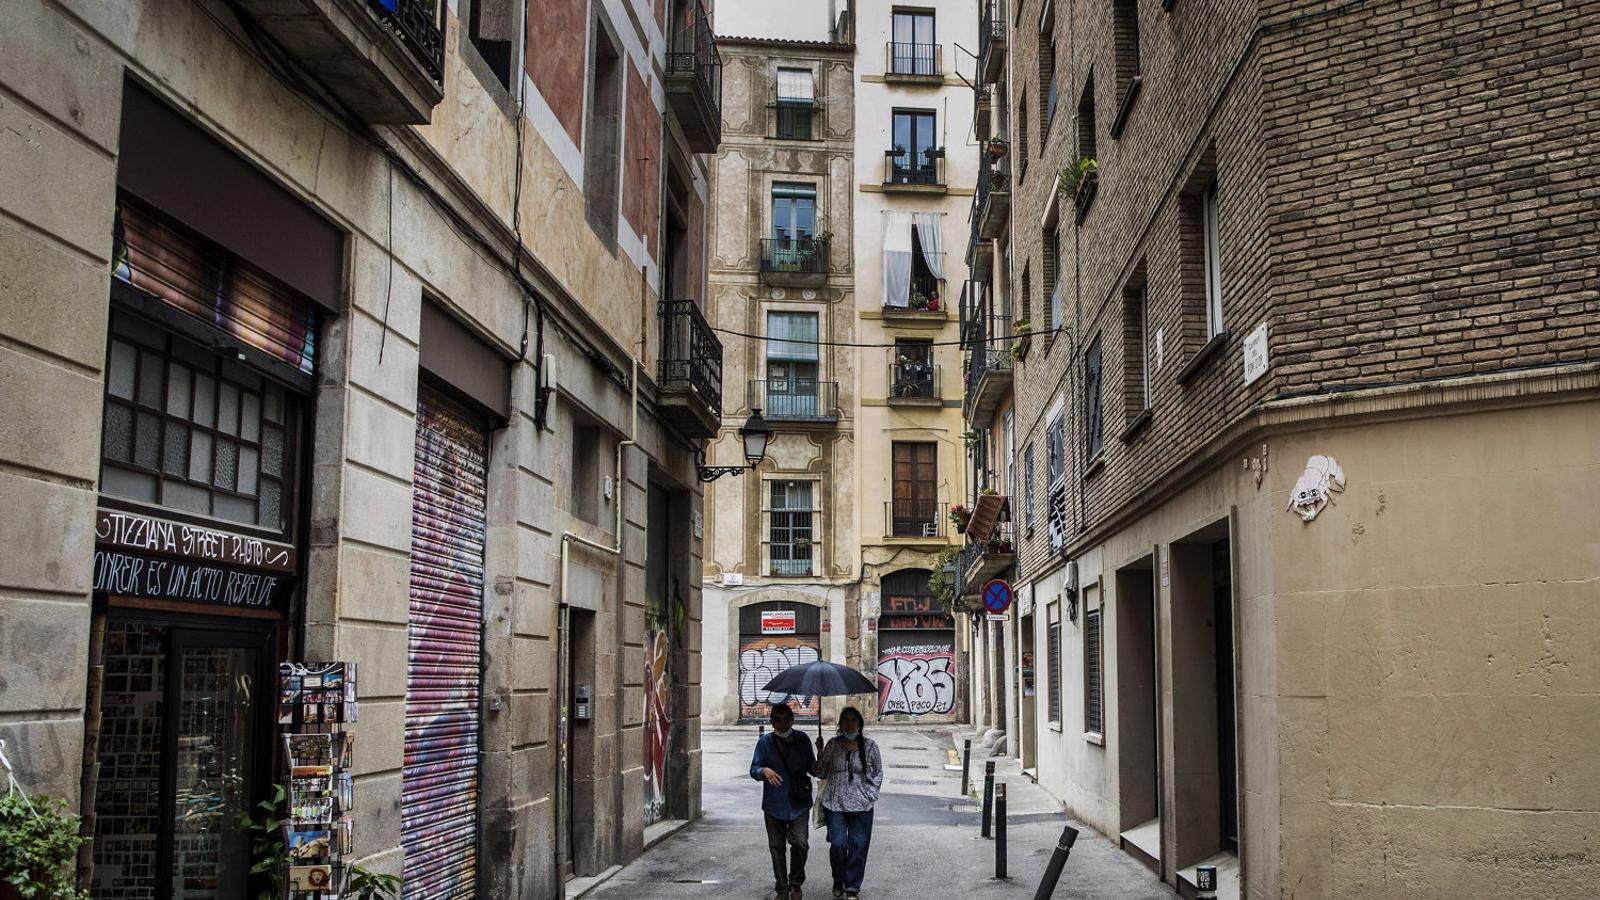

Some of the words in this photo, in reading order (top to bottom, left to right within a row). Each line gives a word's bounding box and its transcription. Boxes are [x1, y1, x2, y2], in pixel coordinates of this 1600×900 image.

[181, 526, 228, 559] STREET
[232, 536, 263, 565] PHOTO
[147, 560, 166, 595] ES
[166, 564, 189, 598] UN
[187, 567, 224, 601] ACTO
[224, 571, 277, 605] REBELDE
